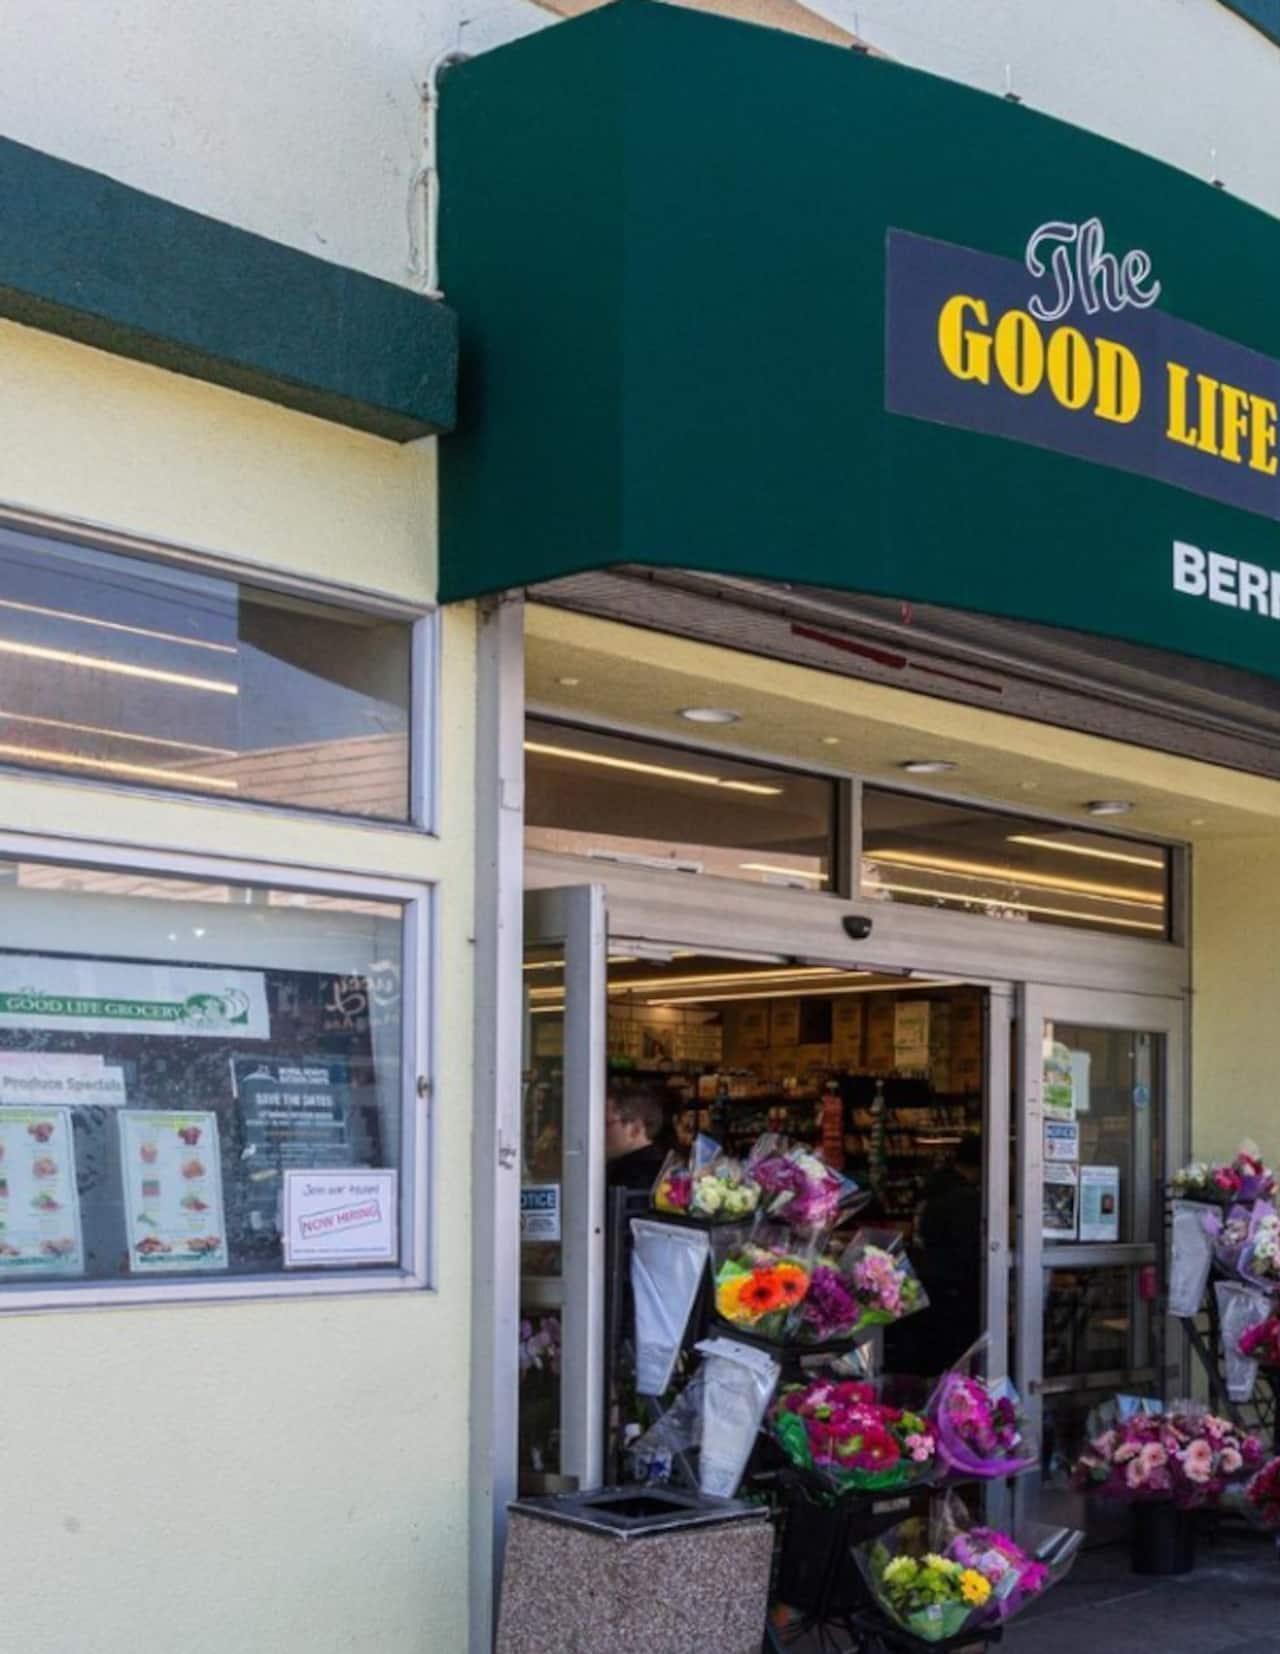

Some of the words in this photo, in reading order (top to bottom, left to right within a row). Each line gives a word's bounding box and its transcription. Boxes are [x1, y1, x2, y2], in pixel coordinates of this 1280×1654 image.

[1025, 216, 1161, 322] The
[937, 294, 1142, 425] GOOD
[1166, 360, 1279, 475] LIFE
[5, 998, 63, 1013] GOOD
[66, 1001, 98, 1015] LIFE
[104, 1003, 183, 1020] GROCERY
[3, 1076, 63, 1091] Produce
[66, 1077, 122, 1093] Specials
[520, 1191, 556, 1208] OTICE
[304, 1215, 334, 1232] NOW
[337, 1206, 376, 1224] HIRING
